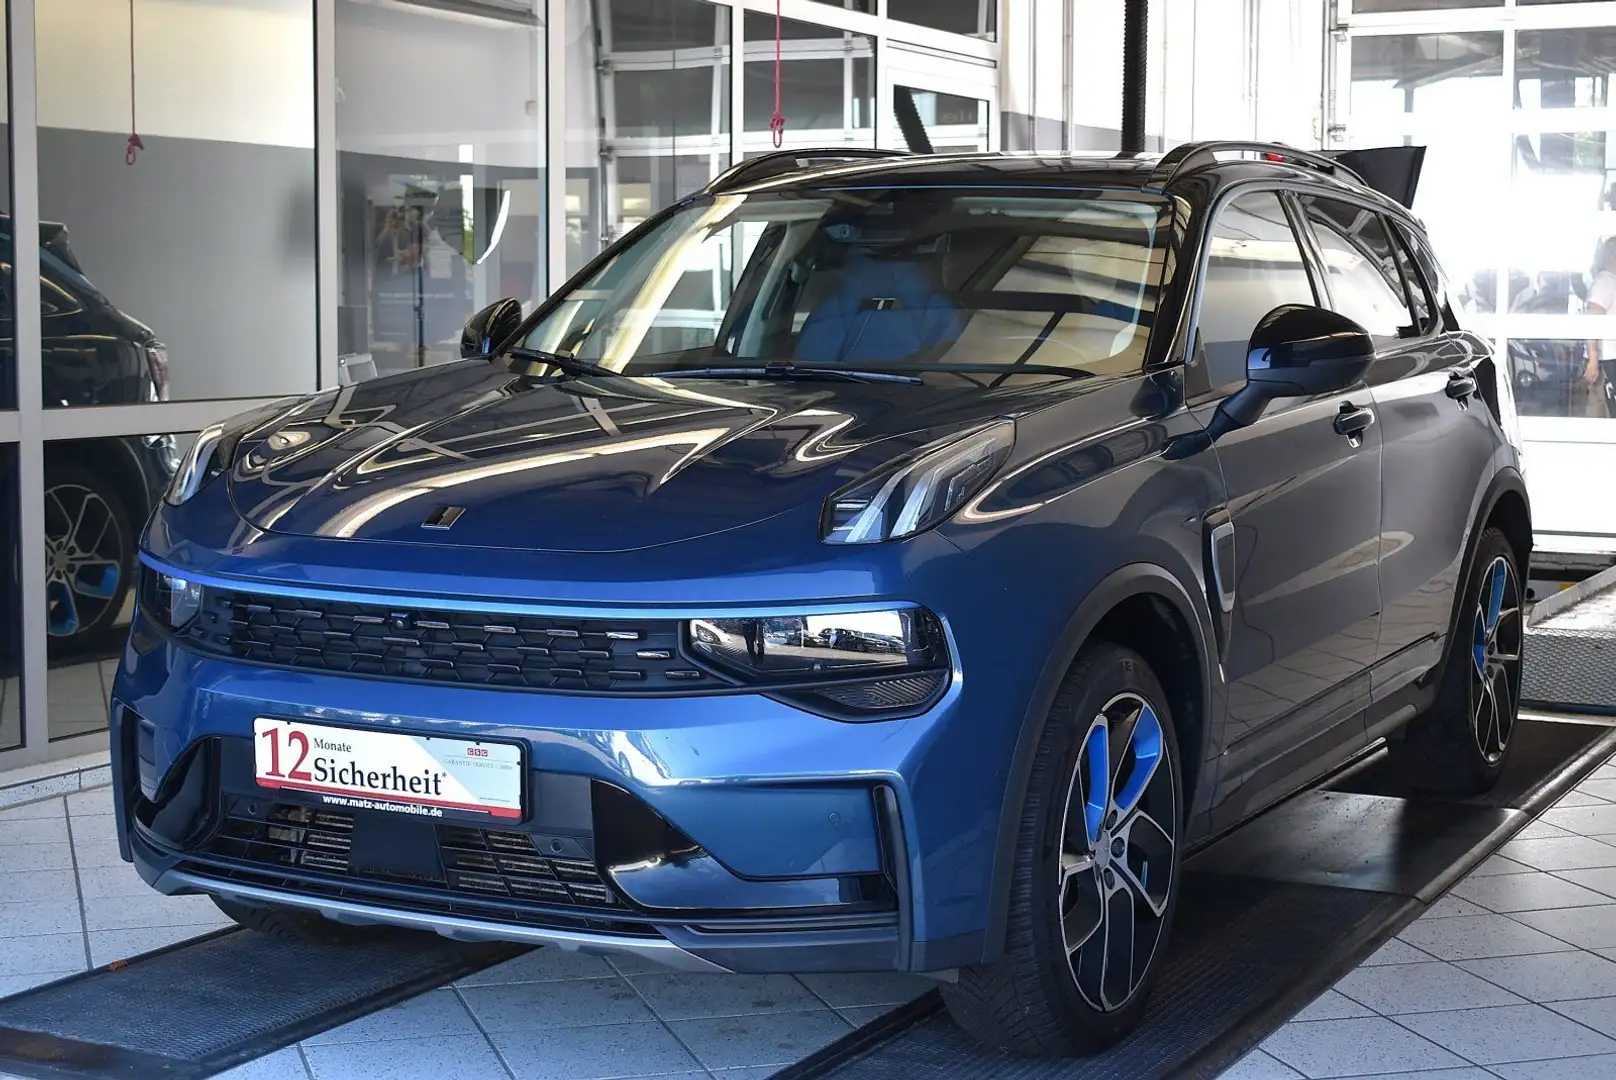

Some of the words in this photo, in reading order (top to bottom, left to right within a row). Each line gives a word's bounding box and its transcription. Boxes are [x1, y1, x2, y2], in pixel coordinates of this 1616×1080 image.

[262, 727, 312, 782] 12
[313, 737, 352, 753] Monate
[322, 795, 443, 817] www.matz-automobile.de
